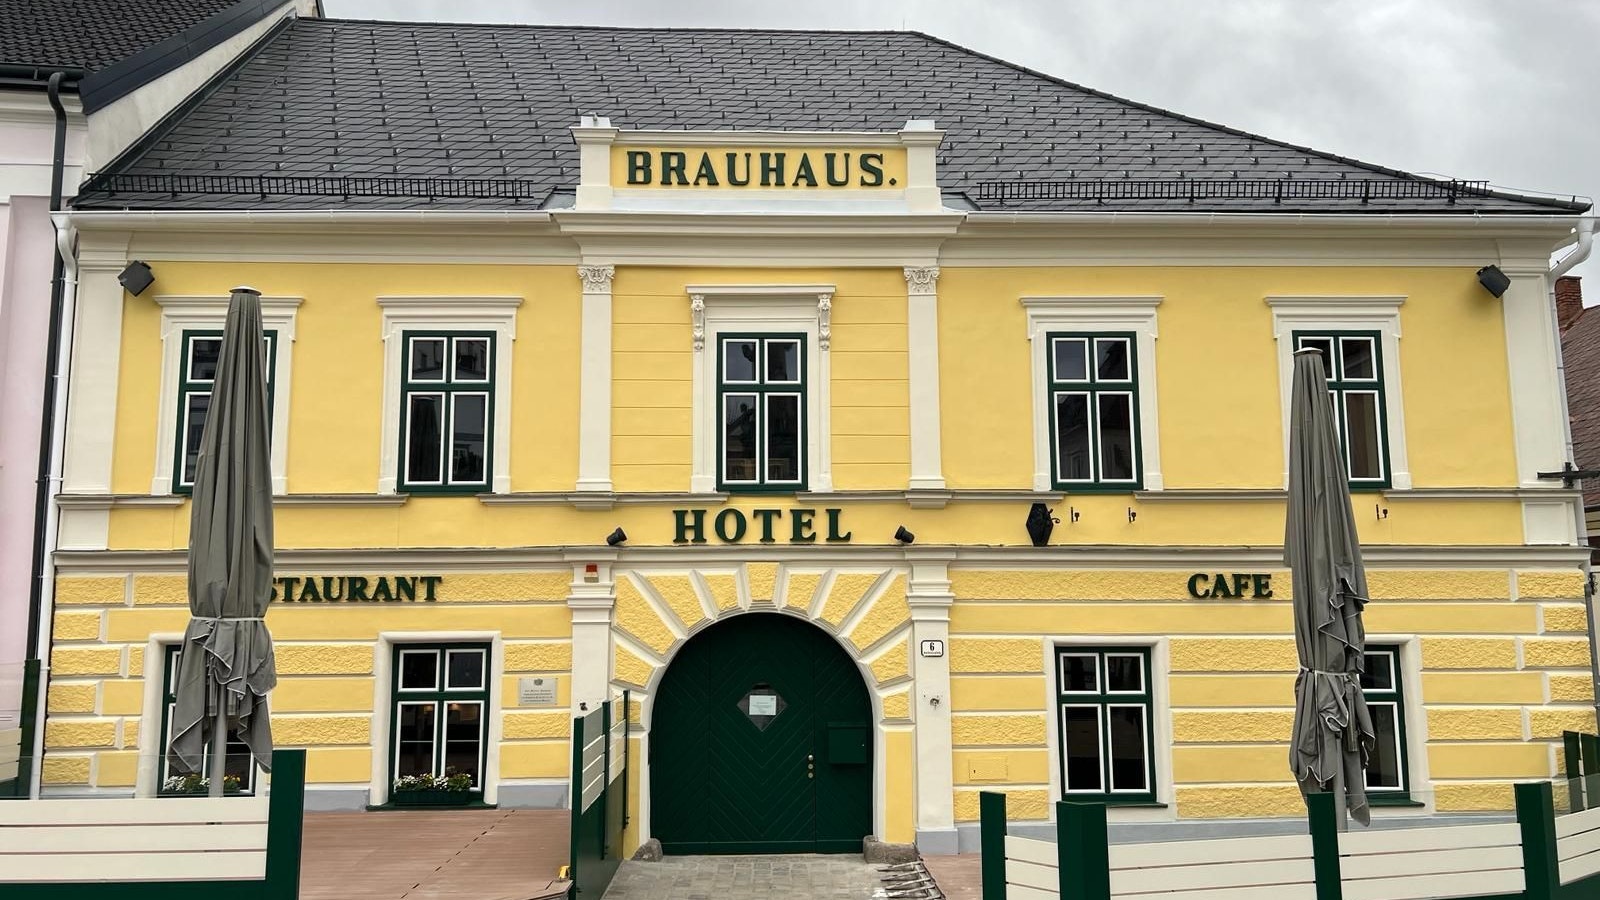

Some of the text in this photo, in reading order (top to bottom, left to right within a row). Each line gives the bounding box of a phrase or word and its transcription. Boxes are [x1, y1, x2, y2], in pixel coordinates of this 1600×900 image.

[626, 151, 897, 187] BRAUHAUS.
[672, 508, 852, 543] HOTEL
[1187, 573, 1273, 599] CAFE
[929, 641, 935, 651] 6
